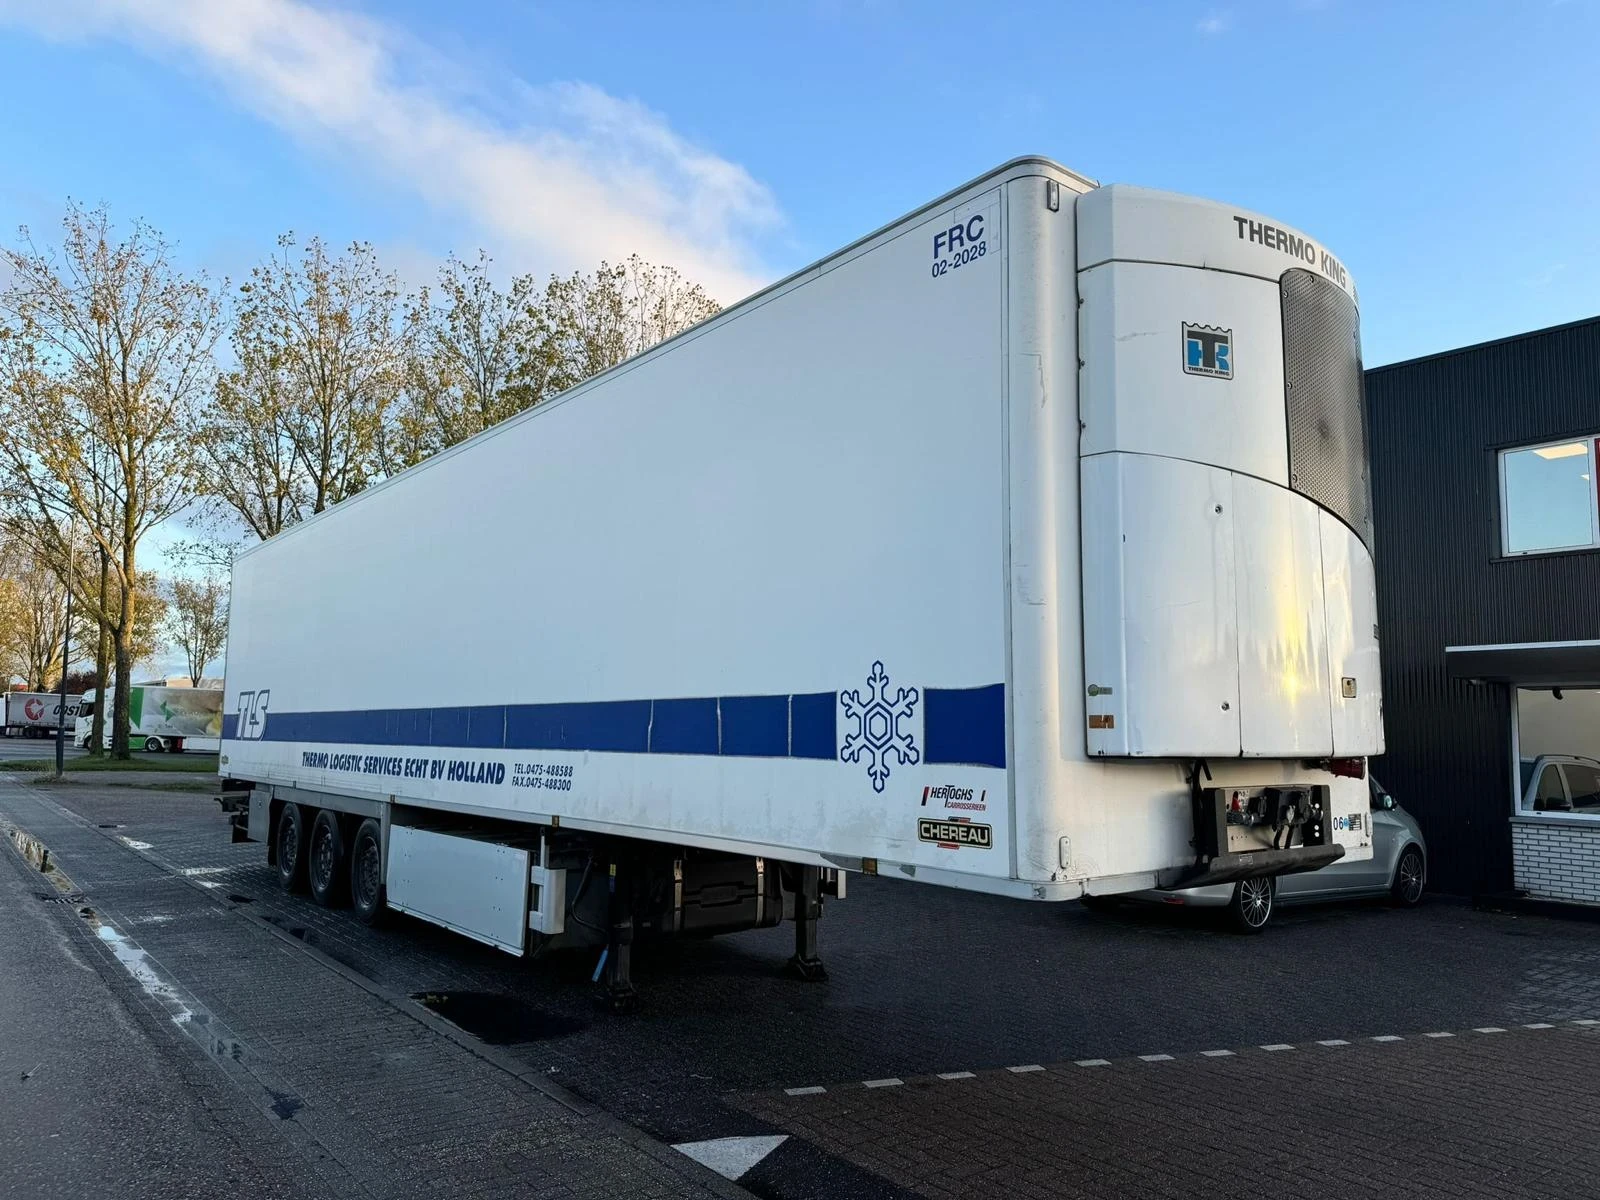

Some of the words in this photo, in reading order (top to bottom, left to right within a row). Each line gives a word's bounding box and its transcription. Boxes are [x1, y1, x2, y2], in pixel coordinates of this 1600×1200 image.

[934, 214, 985, 260] FRC
[931, 240, 987, 278] 02-2028
[1233, 215, 1316, 265] THERMO
[1320, 250, 1347, 289] KING
[1188, 366, 1214, 374] THERMO
[1214, 369, 1230, 377] KING
[235, 688, 271, 742] TLS
[302, 751, 329, 769] THERMO
[329, 753, 362, 773] LOGISTIC
[362, 755, 403, 777] SERVICES
[403, 758, 430, 779] ECHT
[430, 760, 446, 780] BV
[447, 761, 505, 784] HOLLAND
[514, 763, 574, 777] TEL.0475-488588
[512, 775, 573, 792] FAX.0475-488300
[930, 785, 973, 807] HERTOGHS
[921, 824, 988, 844] CHEREAU
